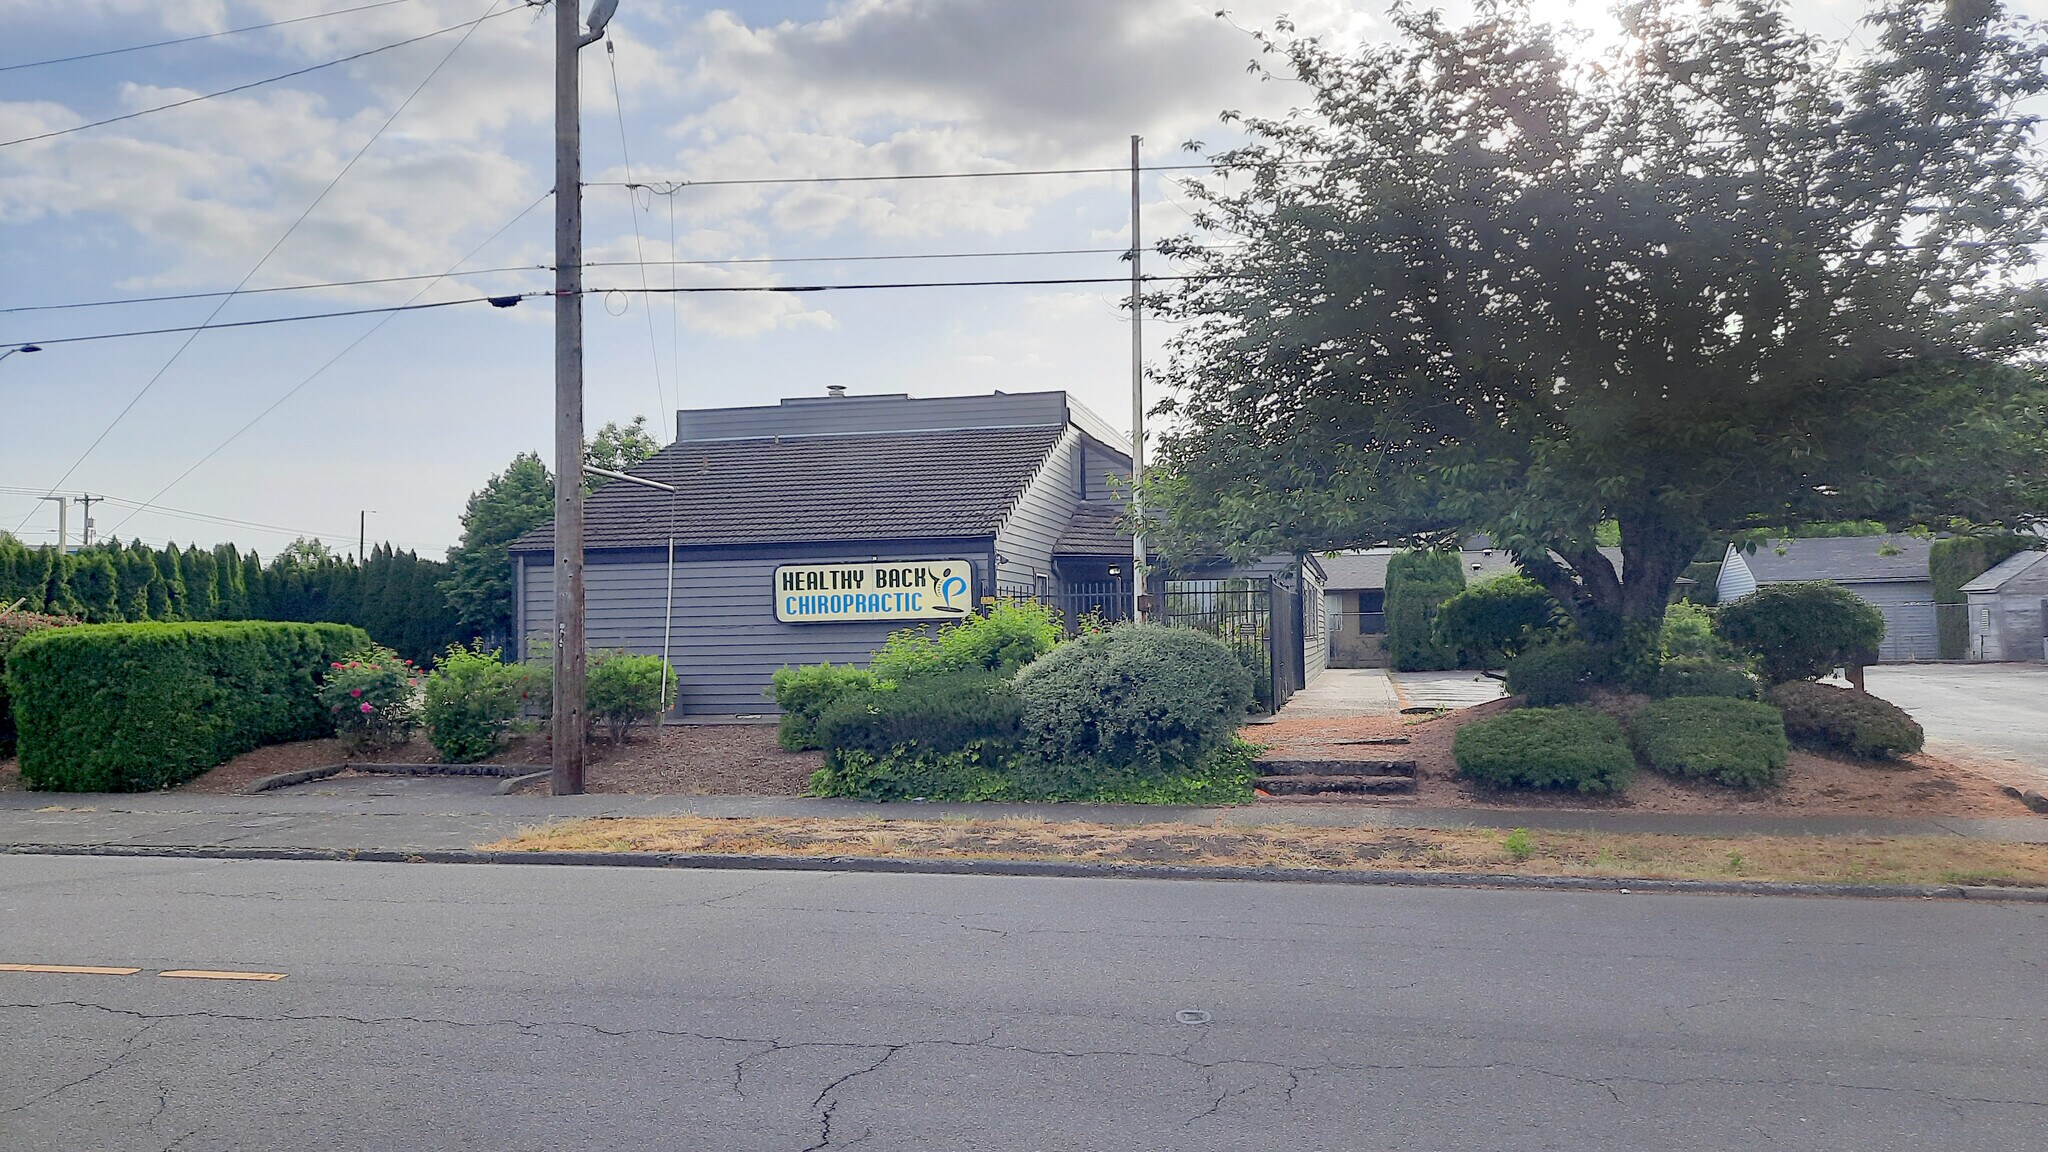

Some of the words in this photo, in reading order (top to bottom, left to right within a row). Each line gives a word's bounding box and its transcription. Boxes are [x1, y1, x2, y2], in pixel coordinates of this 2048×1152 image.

[782, 570, 864, 591] HEALTHY
[876, 567, 926, 589] BACK
[785, 592, 923, 615] CHIROPRACTIC
